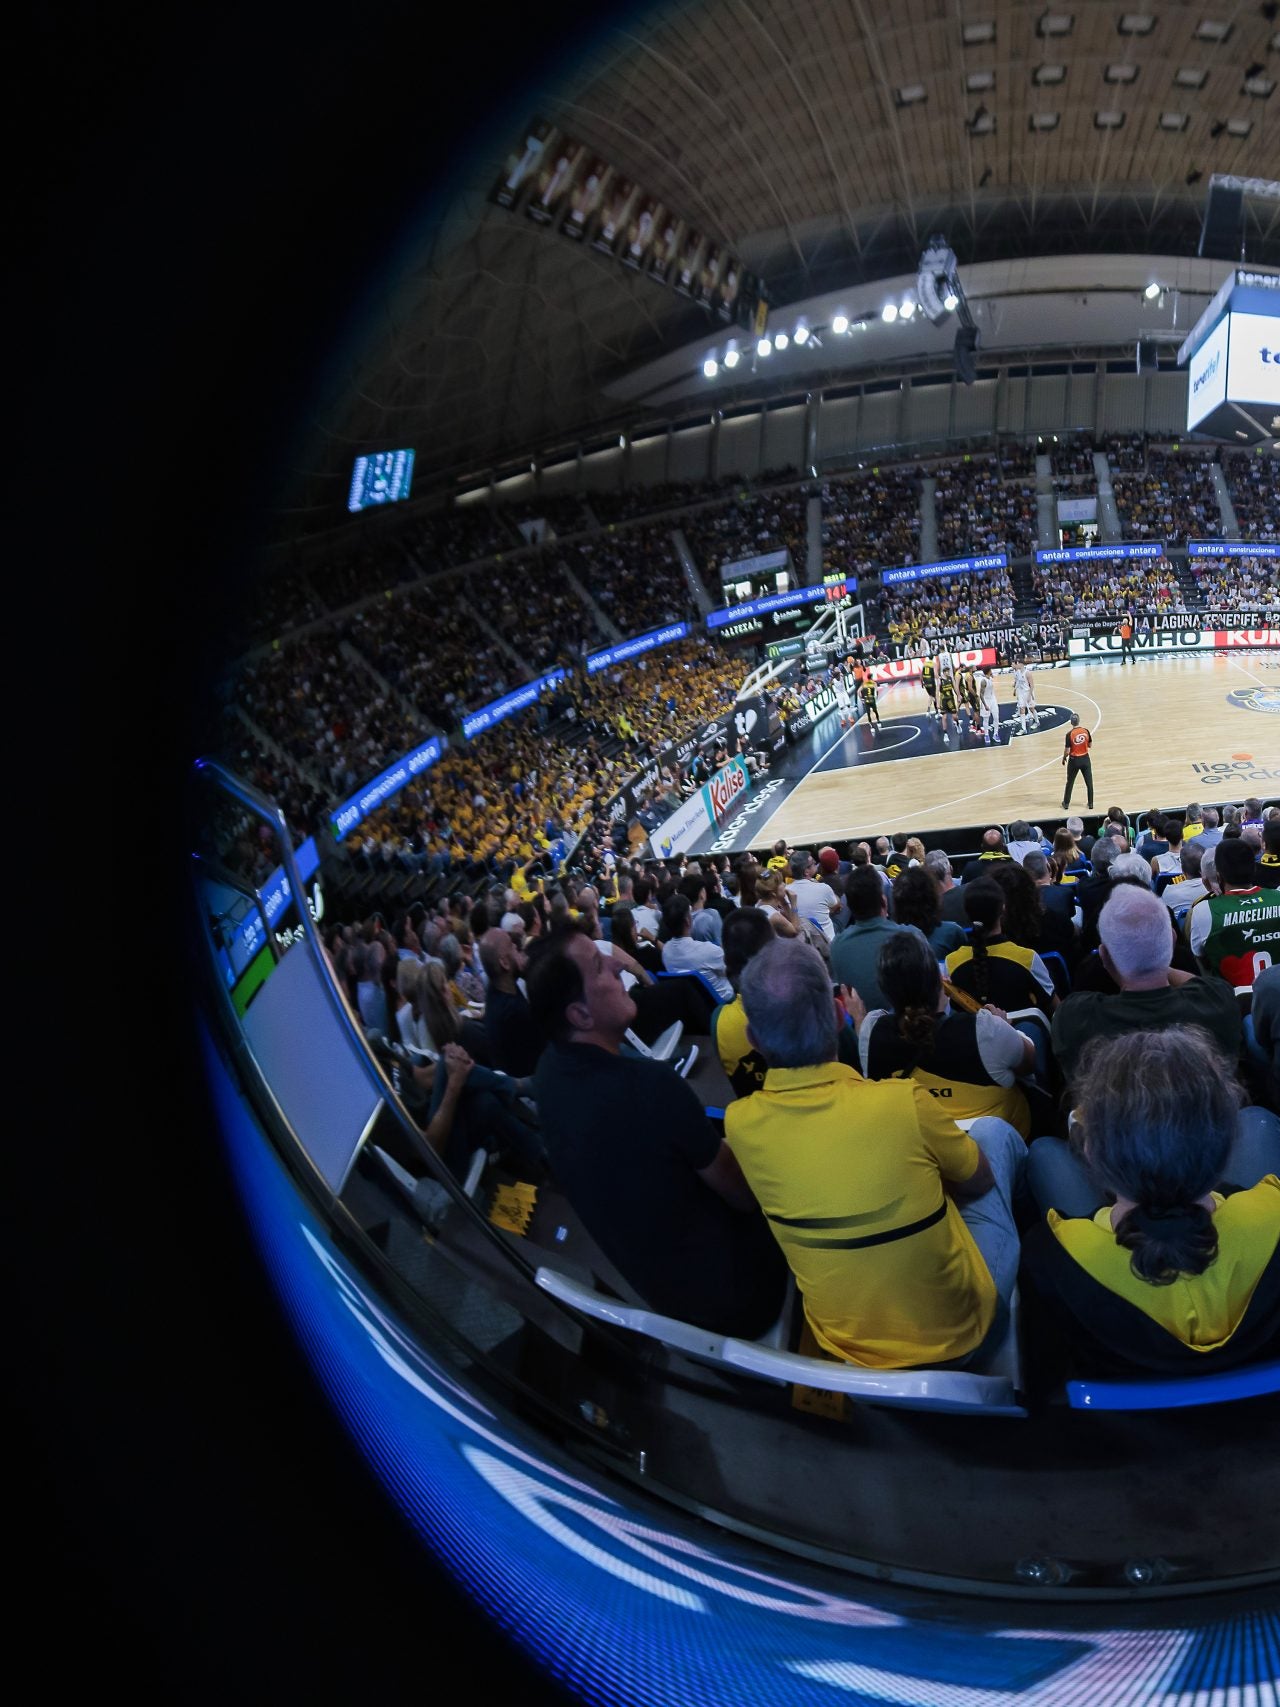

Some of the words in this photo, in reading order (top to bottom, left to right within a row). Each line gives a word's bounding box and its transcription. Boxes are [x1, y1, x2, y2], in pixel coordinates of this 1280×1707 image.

[1042, 550, 1070, 561] antara
[1075, 548, 1125, 559] construcciones
[1129, 545, 1157, 556] antara
[1197, 544, 1224, 554] antara
[1229, 546, 1276, 556] construcciones
[888, 568, 916, 581] antara
[920, 562, 969, 576] construcciones
[974, 556, 1002, 568] antara
[728, 605, 754, 619] antara
[757, 592, 803, 610] construcciones
[657, 626, 683, 643] antara
[1192, 760, 1255, 774] liga
[709, 767, 744, 822] Kalise
